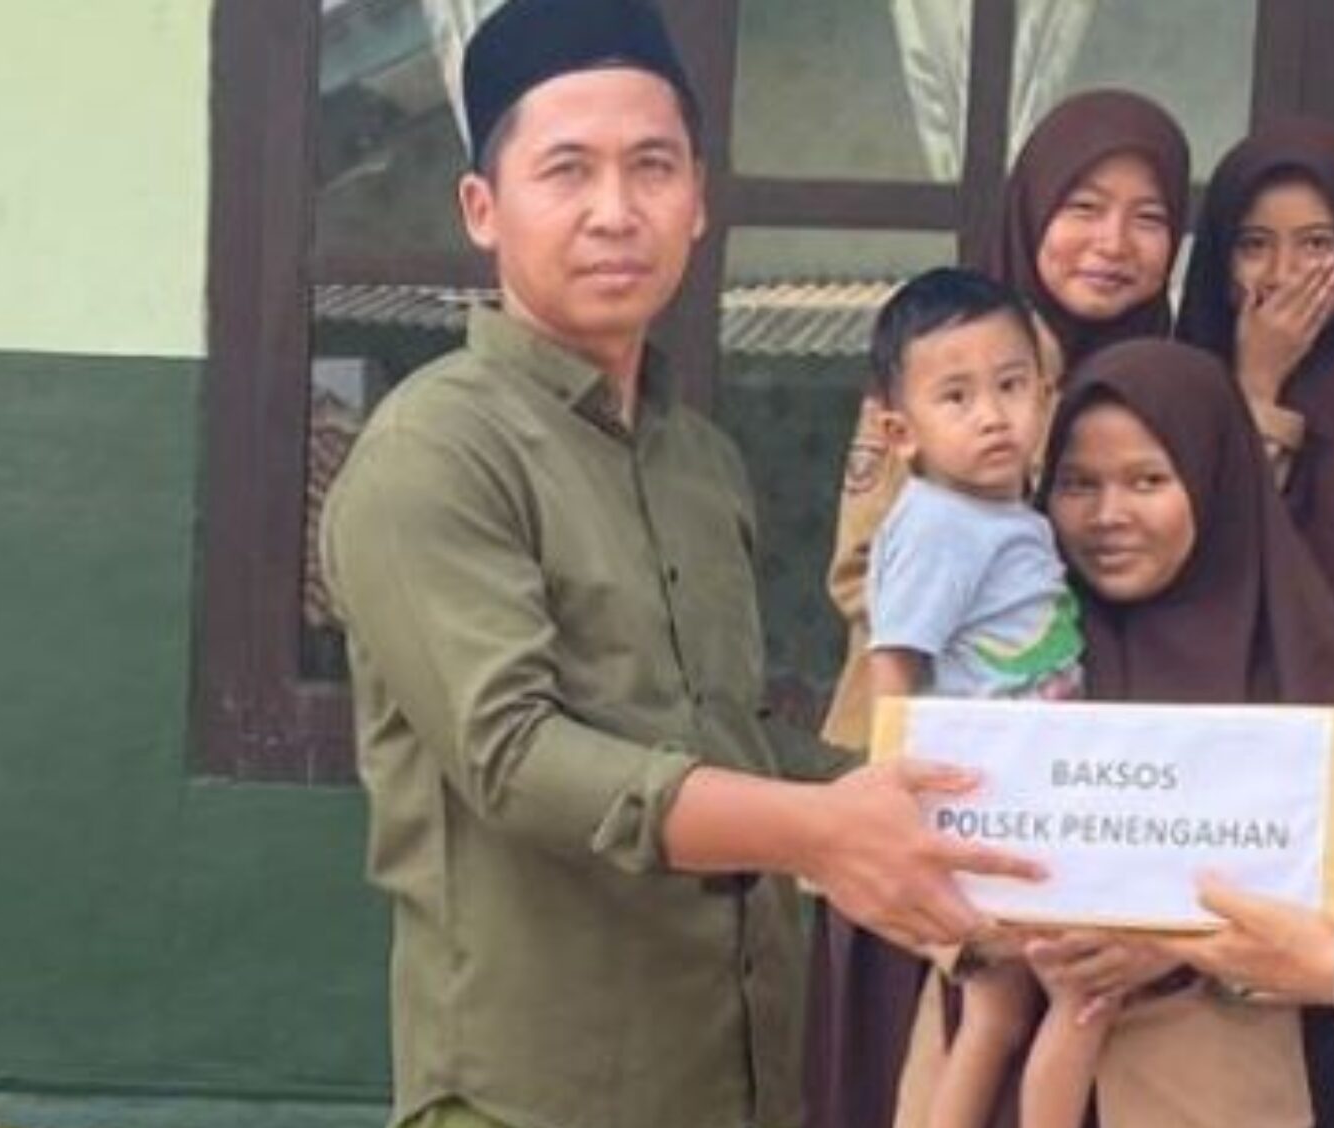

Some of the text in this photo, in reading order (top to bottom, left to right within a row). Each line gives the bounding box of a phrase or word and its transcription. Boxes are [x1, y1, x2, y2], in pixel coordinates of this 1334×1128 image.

[1051, 760, 1179, 791] BAKSOS
[936, 809, 1290, 850] POLSEK PENENGAHAN
